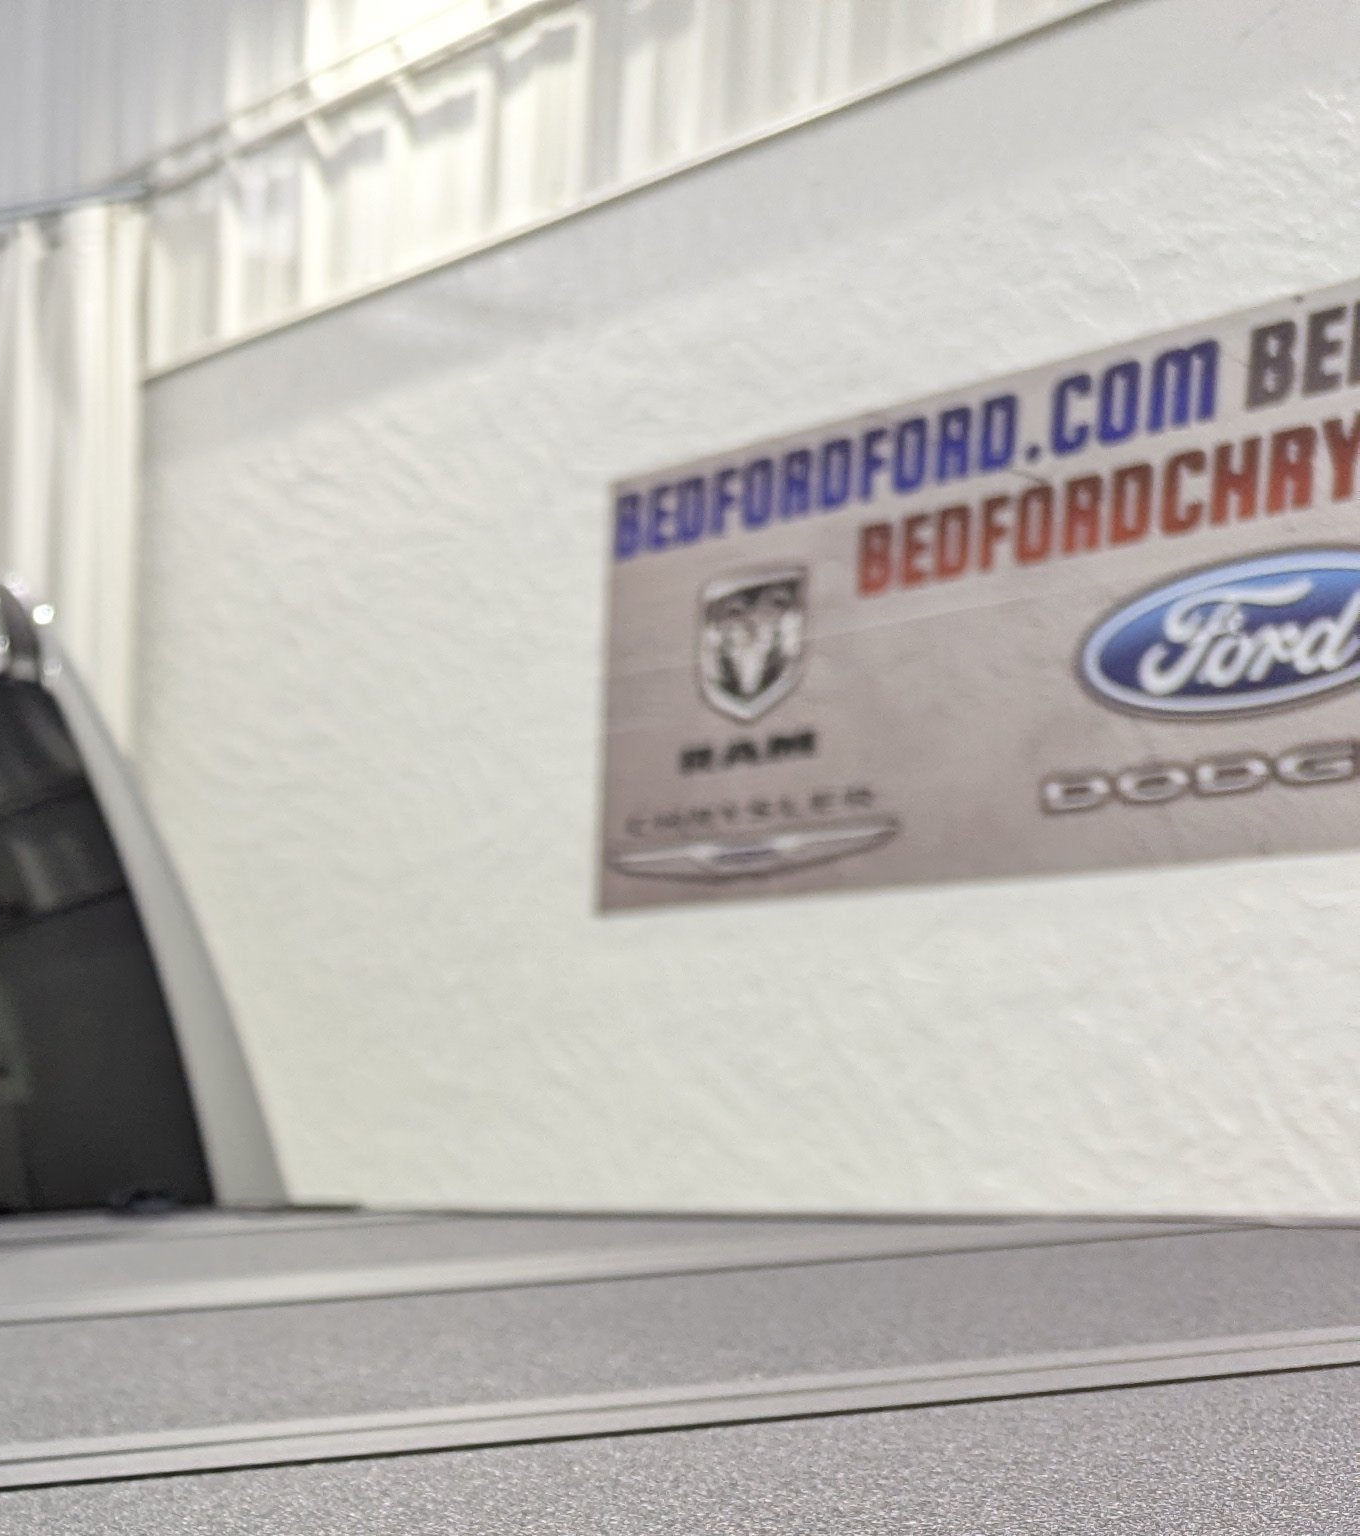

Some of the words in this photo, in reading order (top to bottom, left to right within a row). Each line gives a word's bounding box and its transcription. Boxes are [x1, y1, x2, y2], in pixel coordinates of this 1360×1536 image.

[613, 338, 1220, 562] BEDFORDFORD.COM
[1244, 301, 1360, 410] BE
[855, 411, 1360, 597] BEDFORDCHRY
[1138, 577, 1360, 696] Ford
[679, 731, 817, 776] RAM
[1040, 740, 1360, 815] DODG
